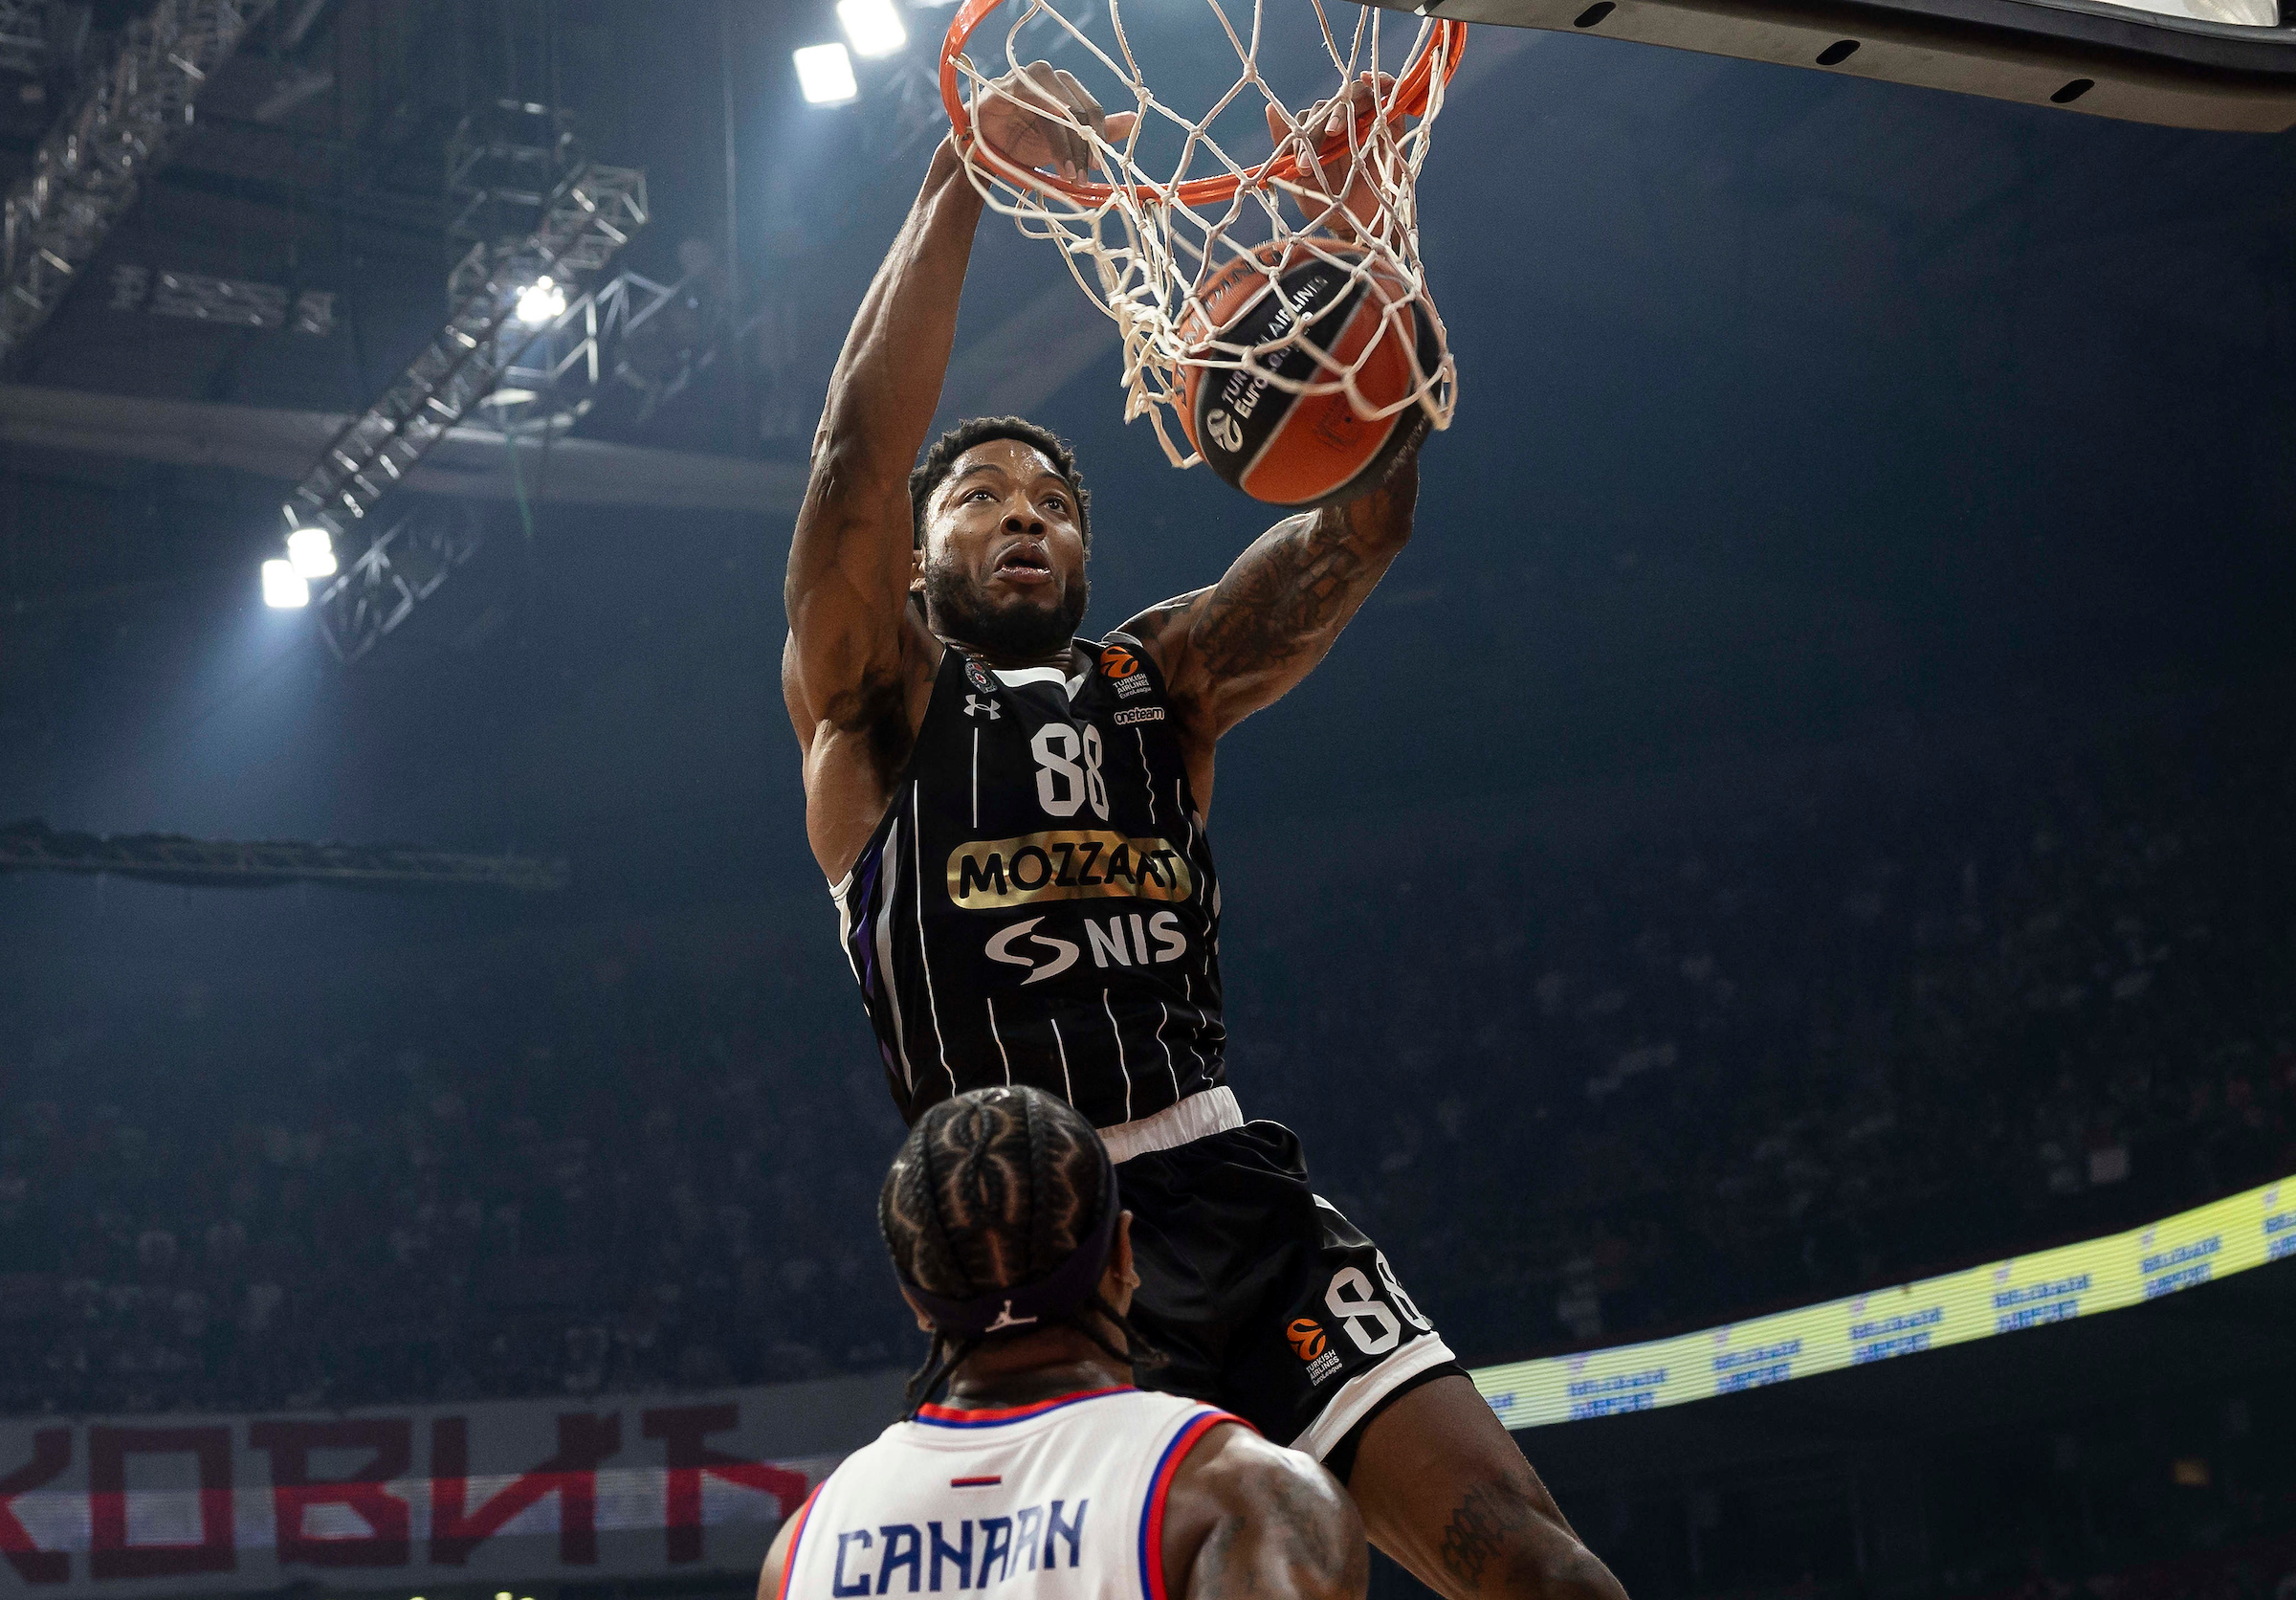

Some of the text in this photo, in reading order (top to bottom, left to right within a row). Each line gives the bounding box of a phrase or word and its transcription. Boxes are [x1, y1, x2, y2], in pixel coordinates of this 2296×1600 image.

[1113, 673, 1147, 688] TURKISH
[1115, 707, 1164, 724] oneteam
[1030, 722, 1109, 821] 88
[1084, 911, 1186, 967] NIS
[1324, 1248, 1432, 1355] 88
[1306, 1349, 1336, 1373] TURKISH
[1310, 1356, 1339, 1380] AIRLINES
[832, 1499, 1090, 1598] CANAAN
